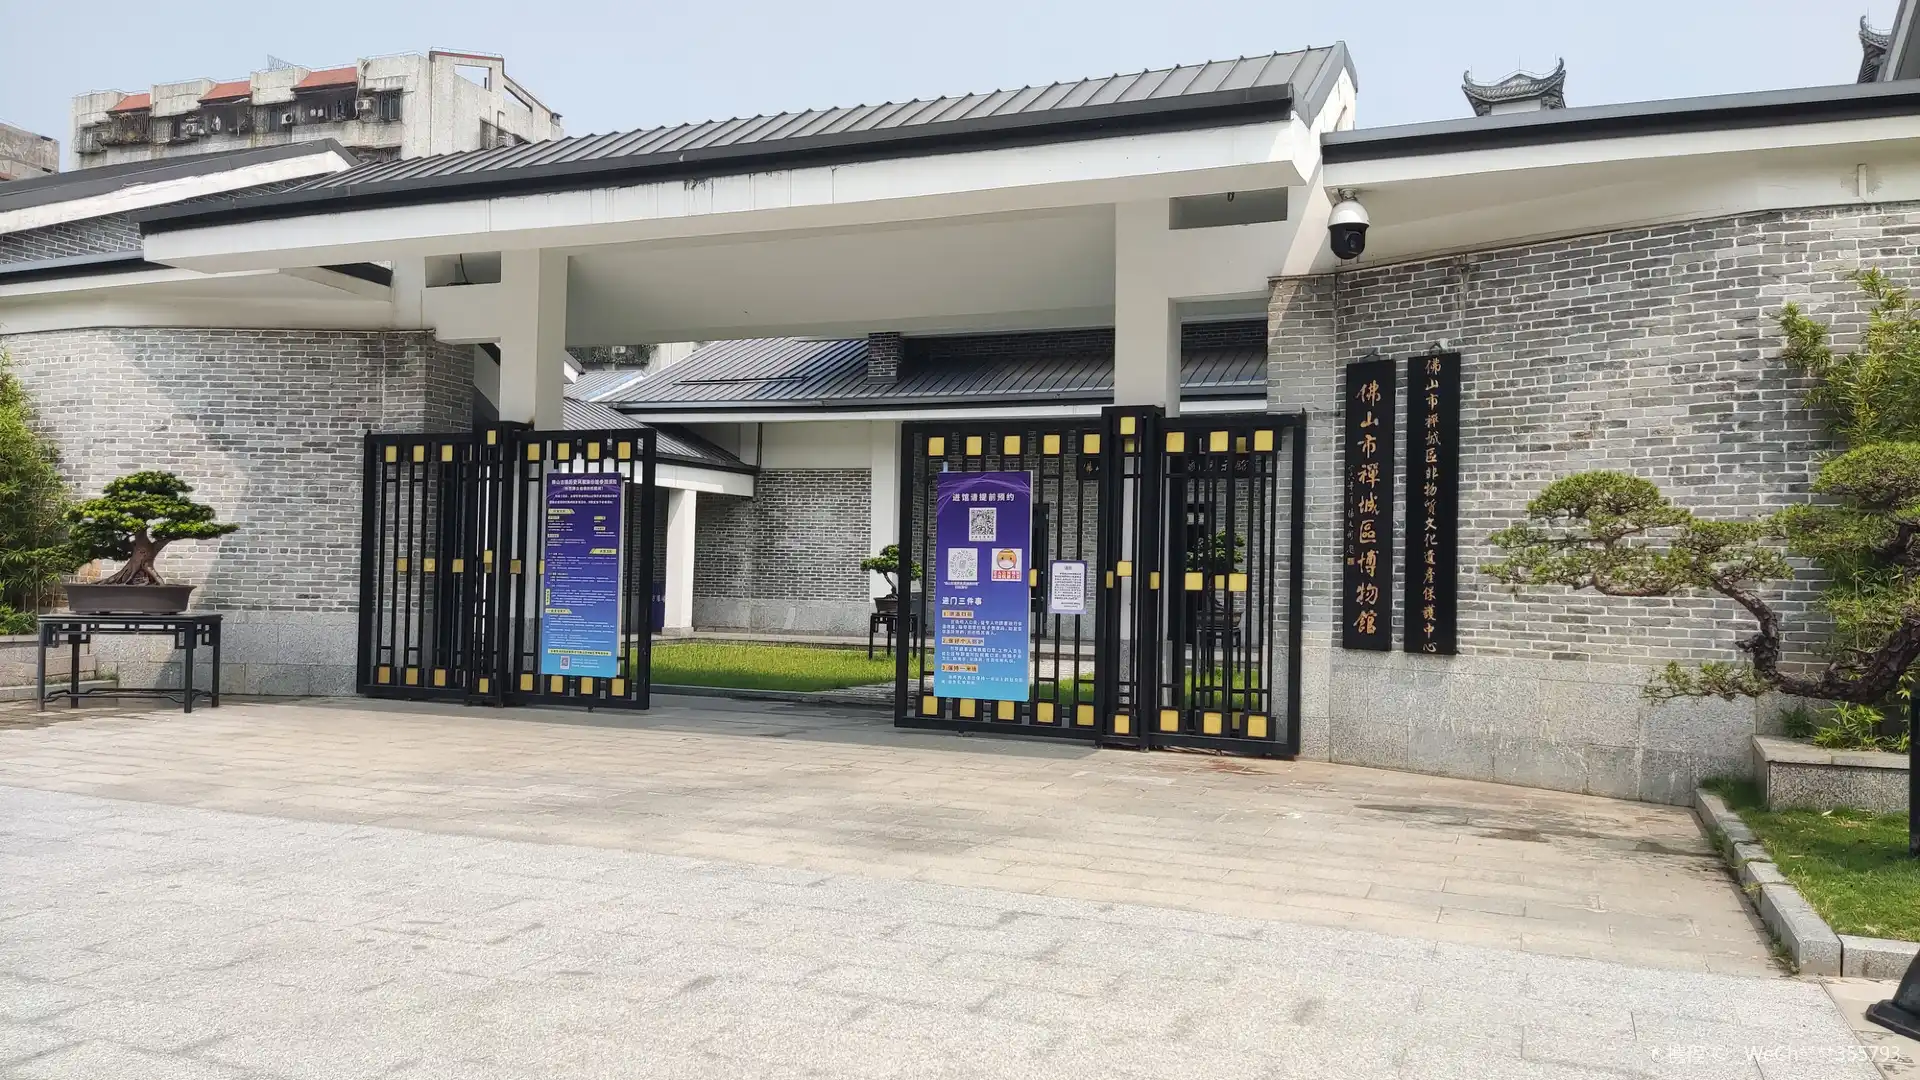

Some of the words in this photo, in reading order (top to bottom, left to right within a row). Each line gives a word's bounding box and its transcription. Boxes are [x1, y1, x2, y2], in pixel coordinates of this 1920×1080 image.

[952, 492, 1015, 502] 进馆请提前预约
[942, 596, 982, 606] 进门三件事
